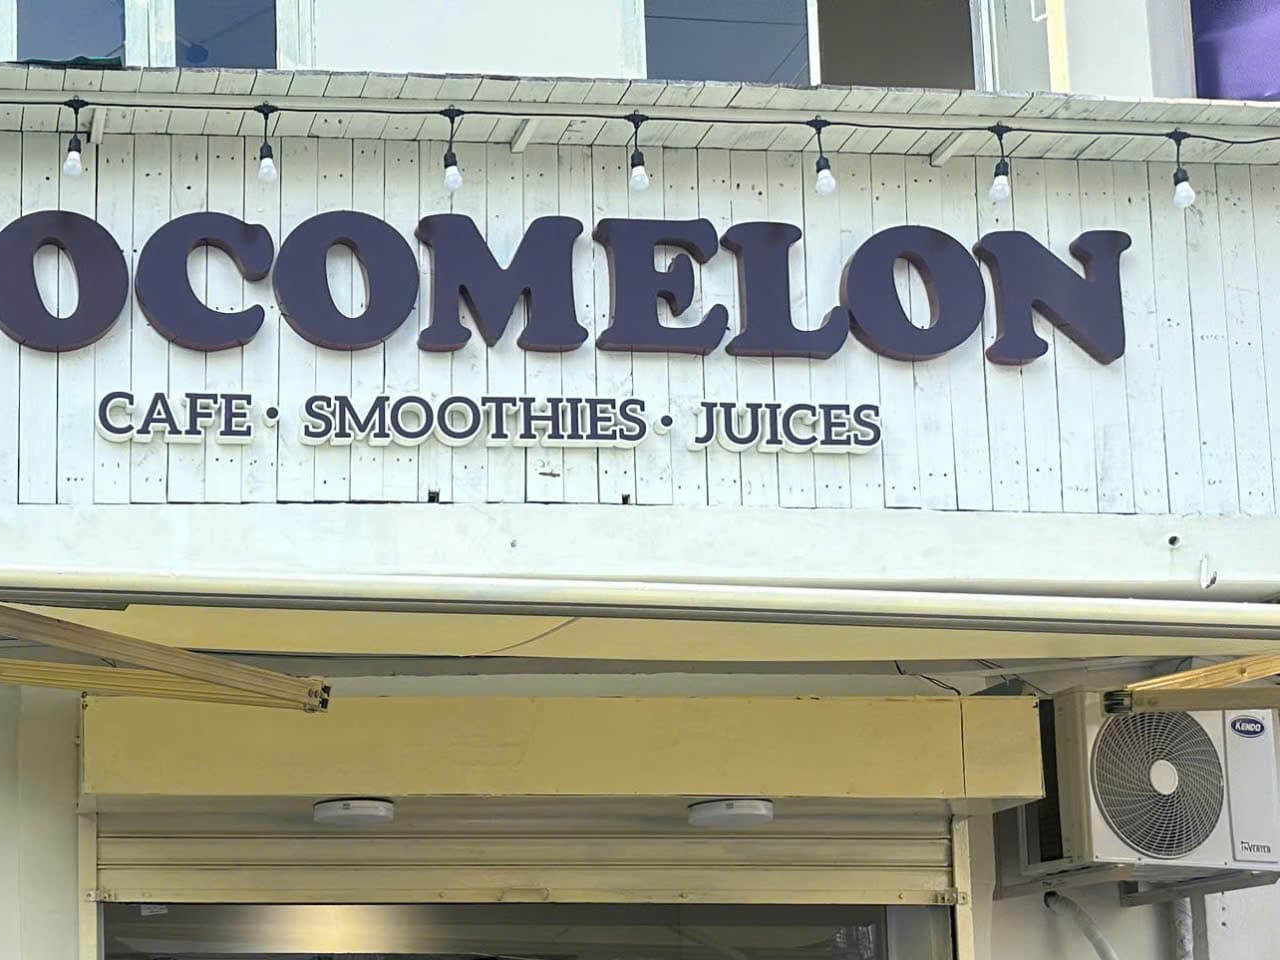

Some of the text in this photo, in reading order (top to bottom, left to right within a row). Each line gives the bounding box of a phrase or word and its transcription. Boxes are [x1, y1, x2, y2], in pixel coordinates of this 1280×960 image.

[99, 393, 882, 447] CAFE SMOOTHIES JUICES
[1234, 719, 1261, 732] KENDO
